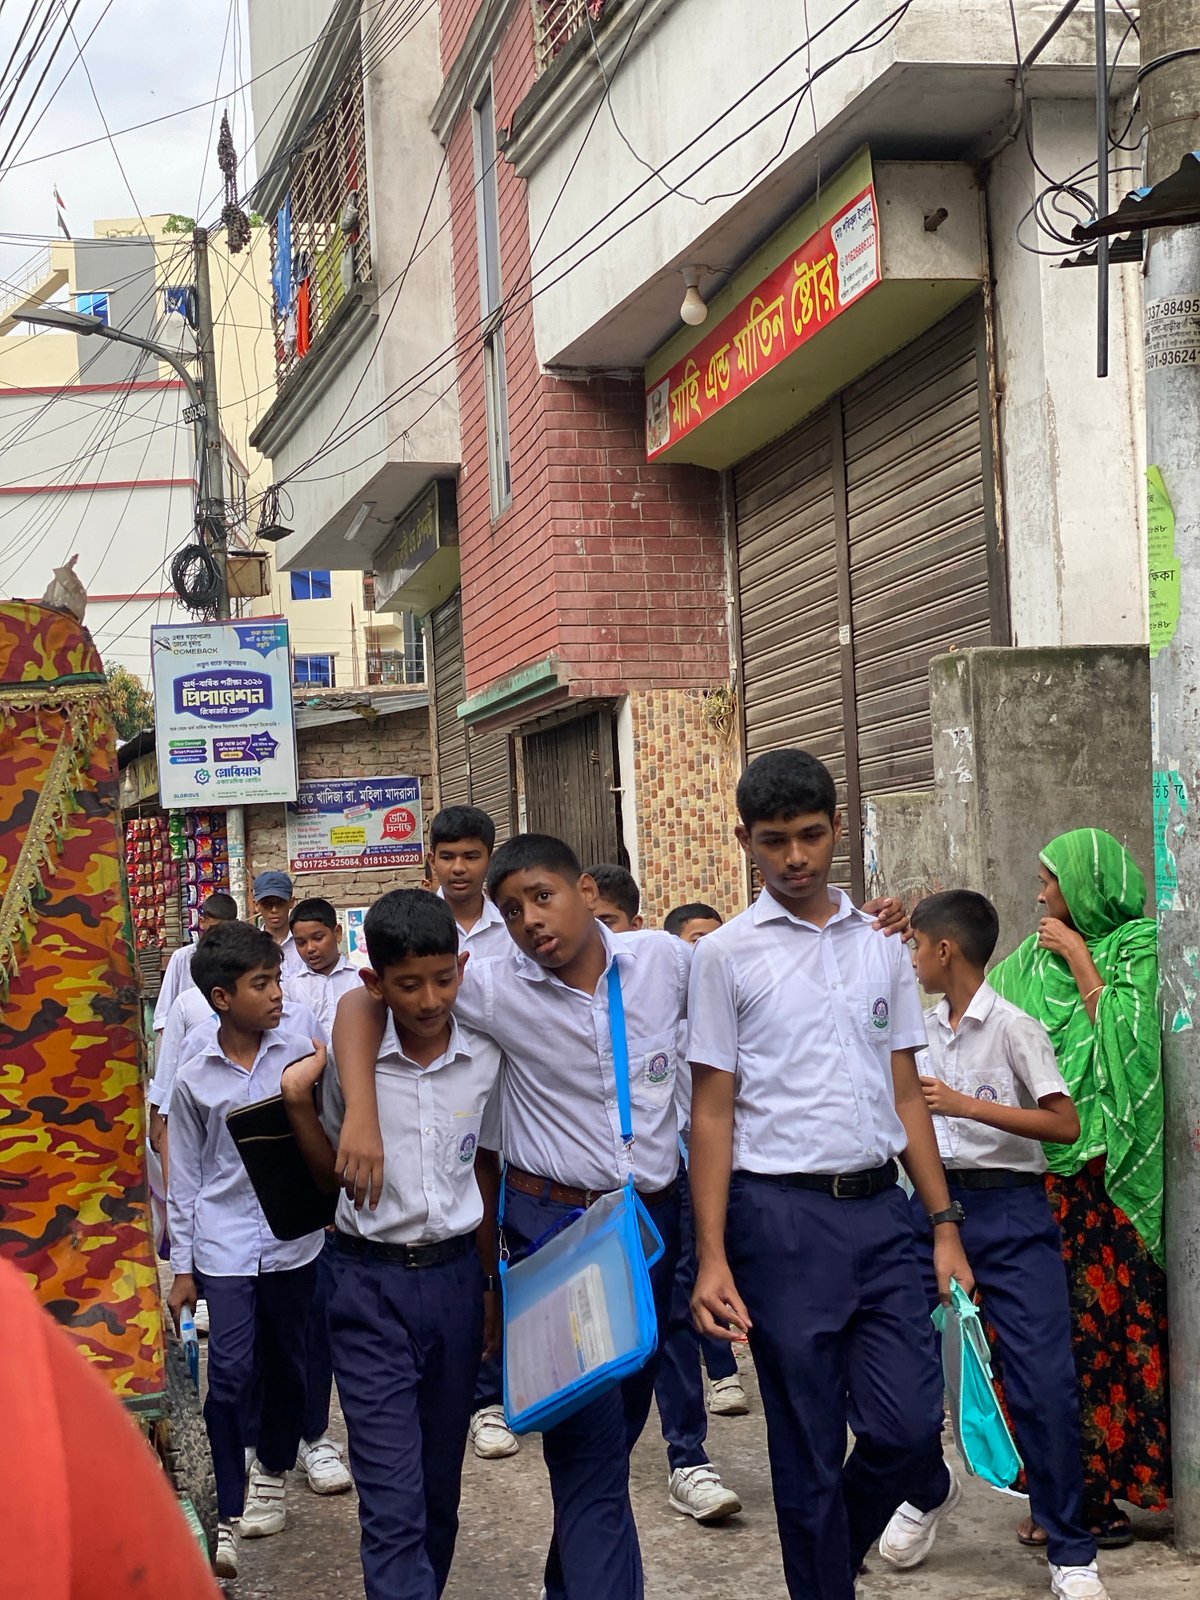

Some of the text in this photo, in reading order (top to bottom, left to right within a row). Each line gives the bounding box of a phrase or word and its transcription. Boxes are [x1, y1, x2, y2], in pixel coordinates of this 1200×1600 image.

[670, 360, 702, 430] মাহি
[705, 343, 731, 402] এন্ড
[733, 297, 787, 379] মাতিন
[791, 252, 836, 337] ষ্টোর
[173, 647, 218, 656] COMEBACK
[220, 677, 242, 687] পরীক্ষা
[182, 688, 265, 707] প্রিপারেশন
[215, 764, 261, 778] গ্লোরিয়াস
[173, 792, 200, 800] GLORIOUS
[316, 787, 344, 804] খাদিজা
[344, 790, 358, 803] রা.
[359, 785, 383, 804] মহিলা
[385, 786, 416, 800] মাদরাসা
[389, 811, 409, 823] ভর্তি
[386, 822, 412, 833] চলছে
[364, 854, 420, 865] 01813-330220
